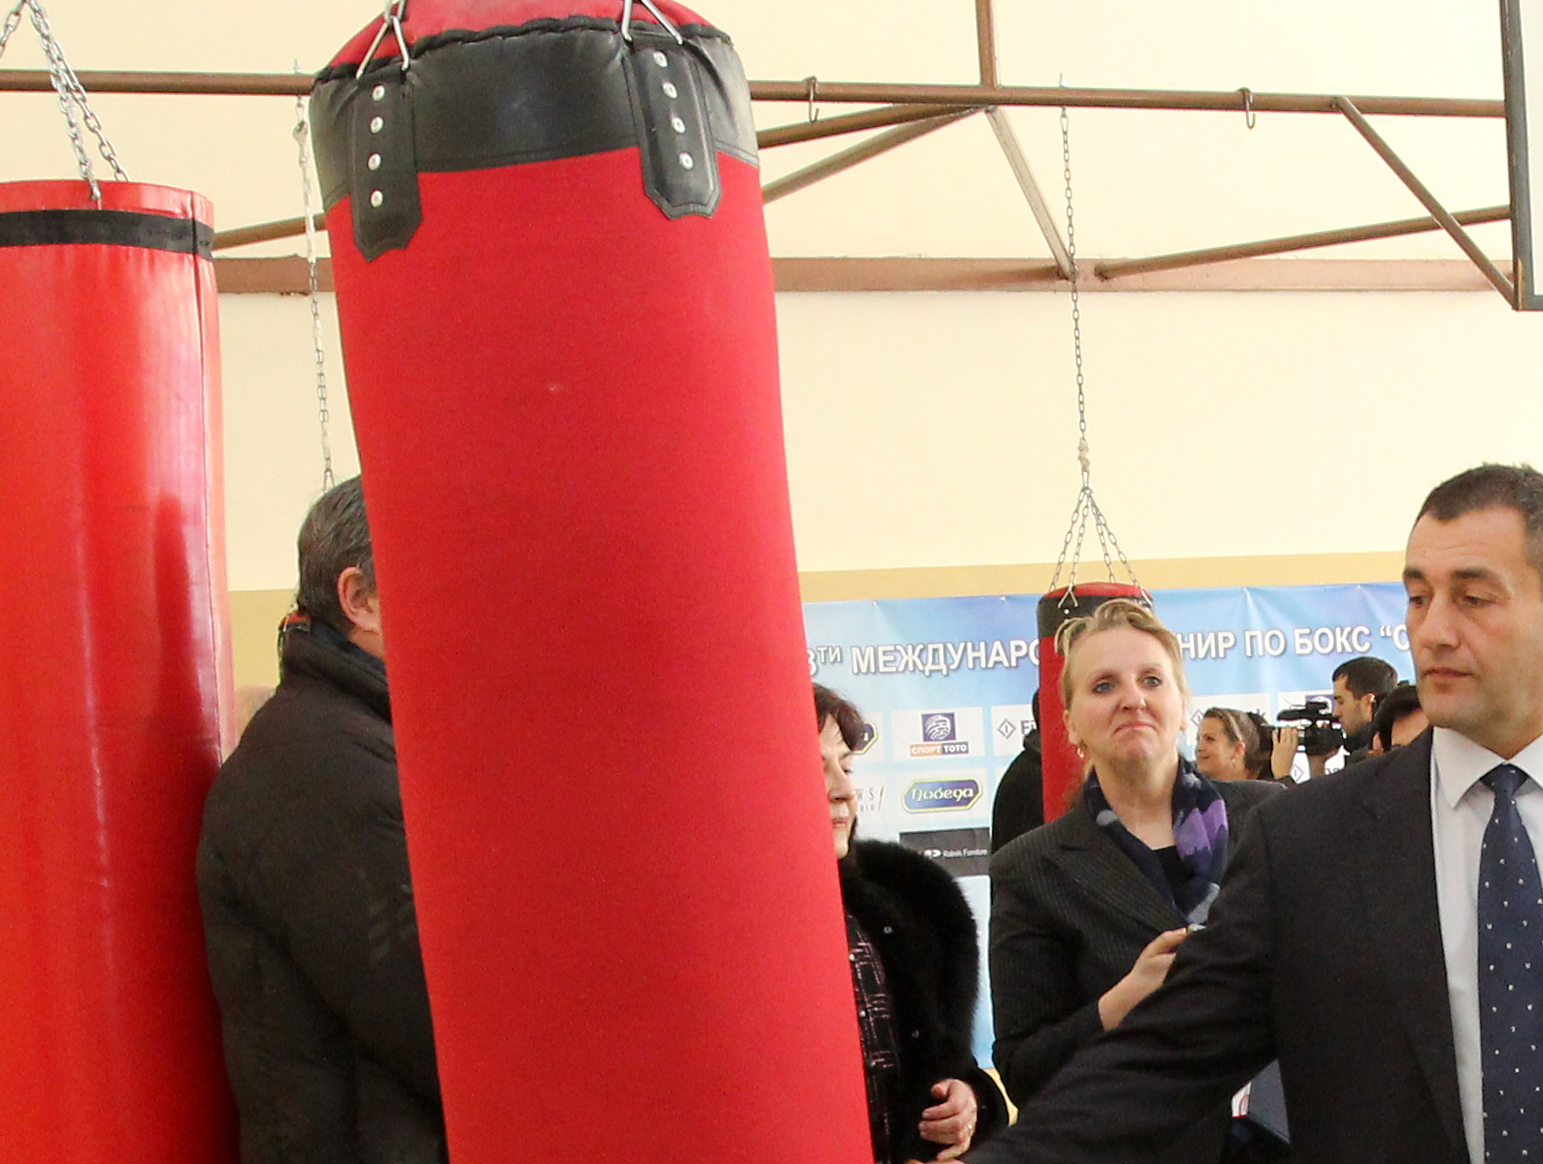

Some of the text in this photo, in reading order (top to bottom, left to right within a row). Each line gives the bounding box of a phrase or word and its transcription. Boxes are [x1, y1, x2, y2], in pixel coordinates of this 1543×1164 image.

[1244, 629, 1286, 657] ПО
[1294, 626, 1371, 655] БОКС
[911, 745, 941, 755] СПОРТ
